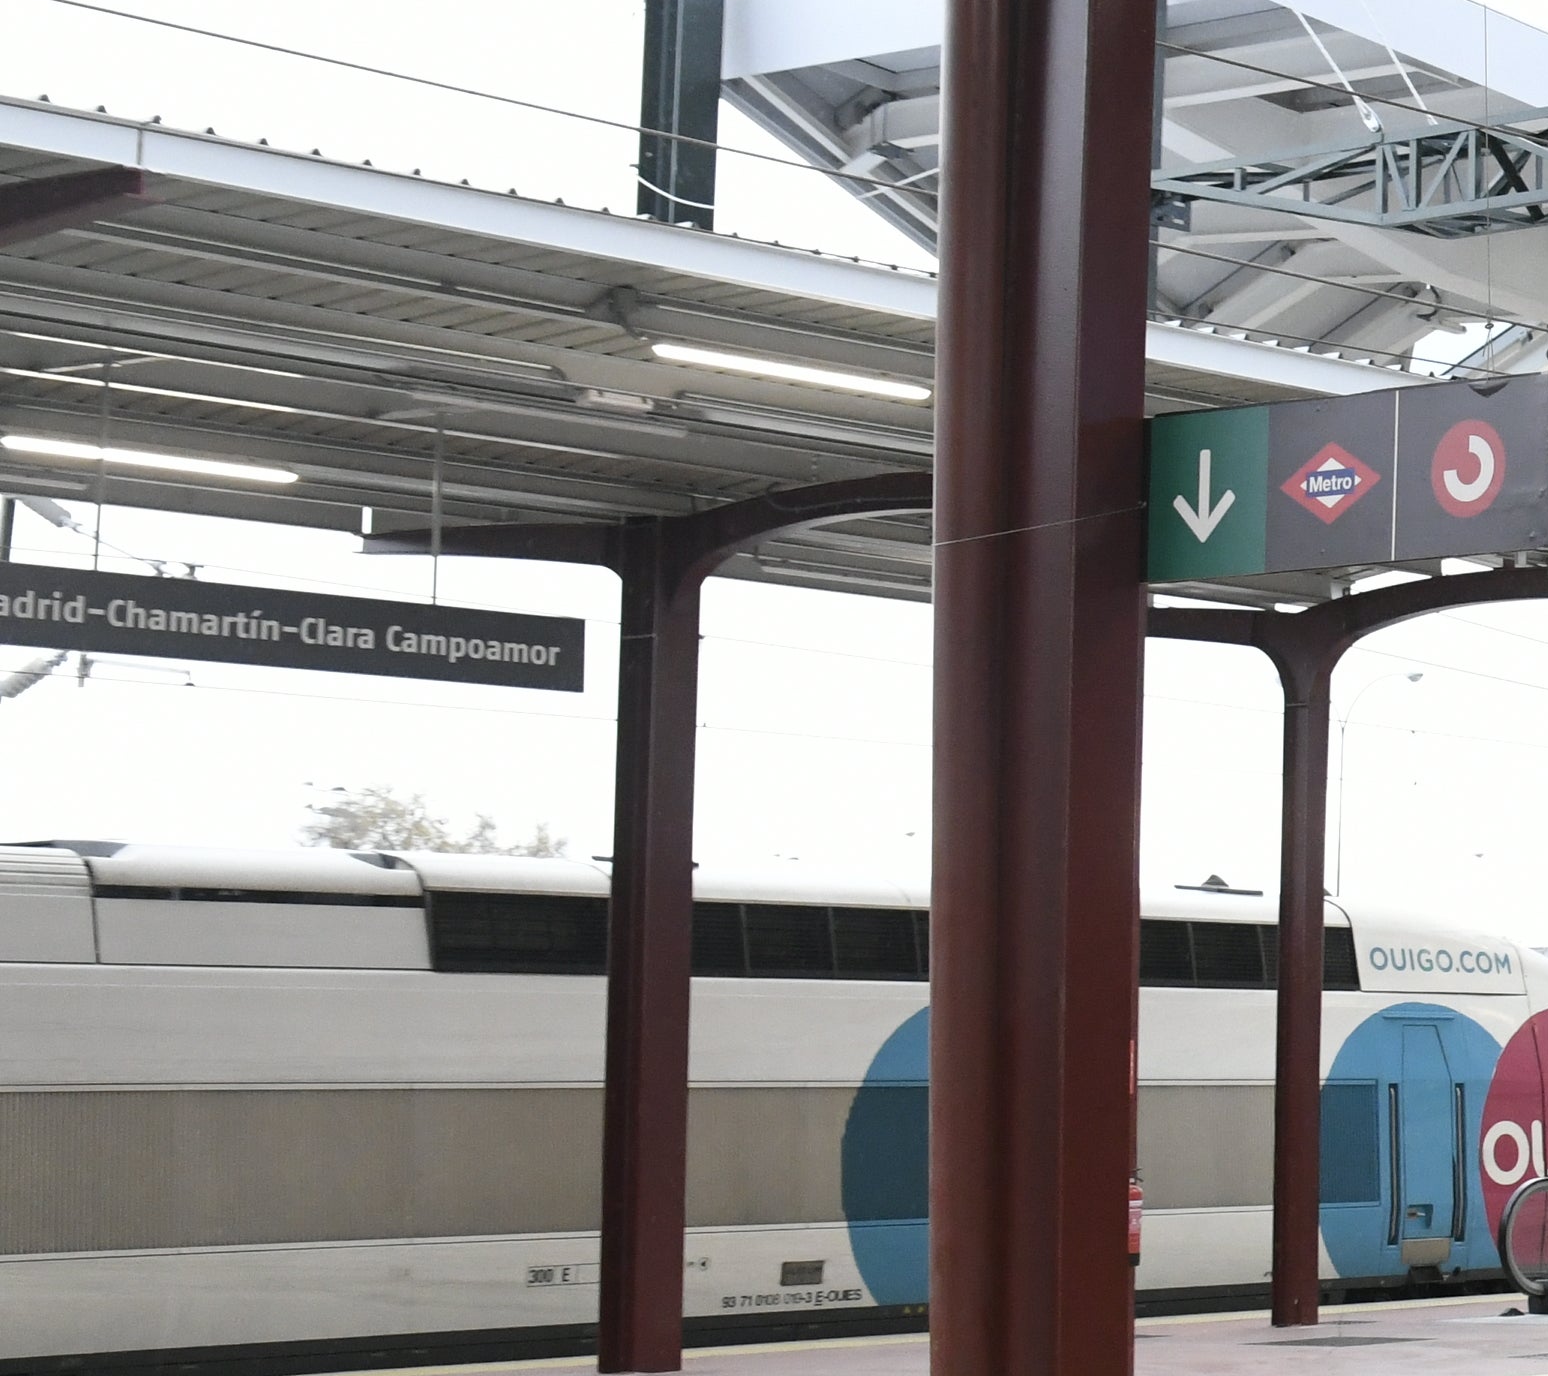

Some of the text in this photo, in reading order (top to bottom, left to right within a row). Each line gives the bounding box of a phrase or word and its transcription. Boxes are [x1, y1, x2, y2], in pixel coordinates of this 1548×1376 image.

[1309, 475, 1352, 493] Metro
[386, 625, 560, 666] Campoamor
[1370, 946, 1511, 975] OUIGO.COM
